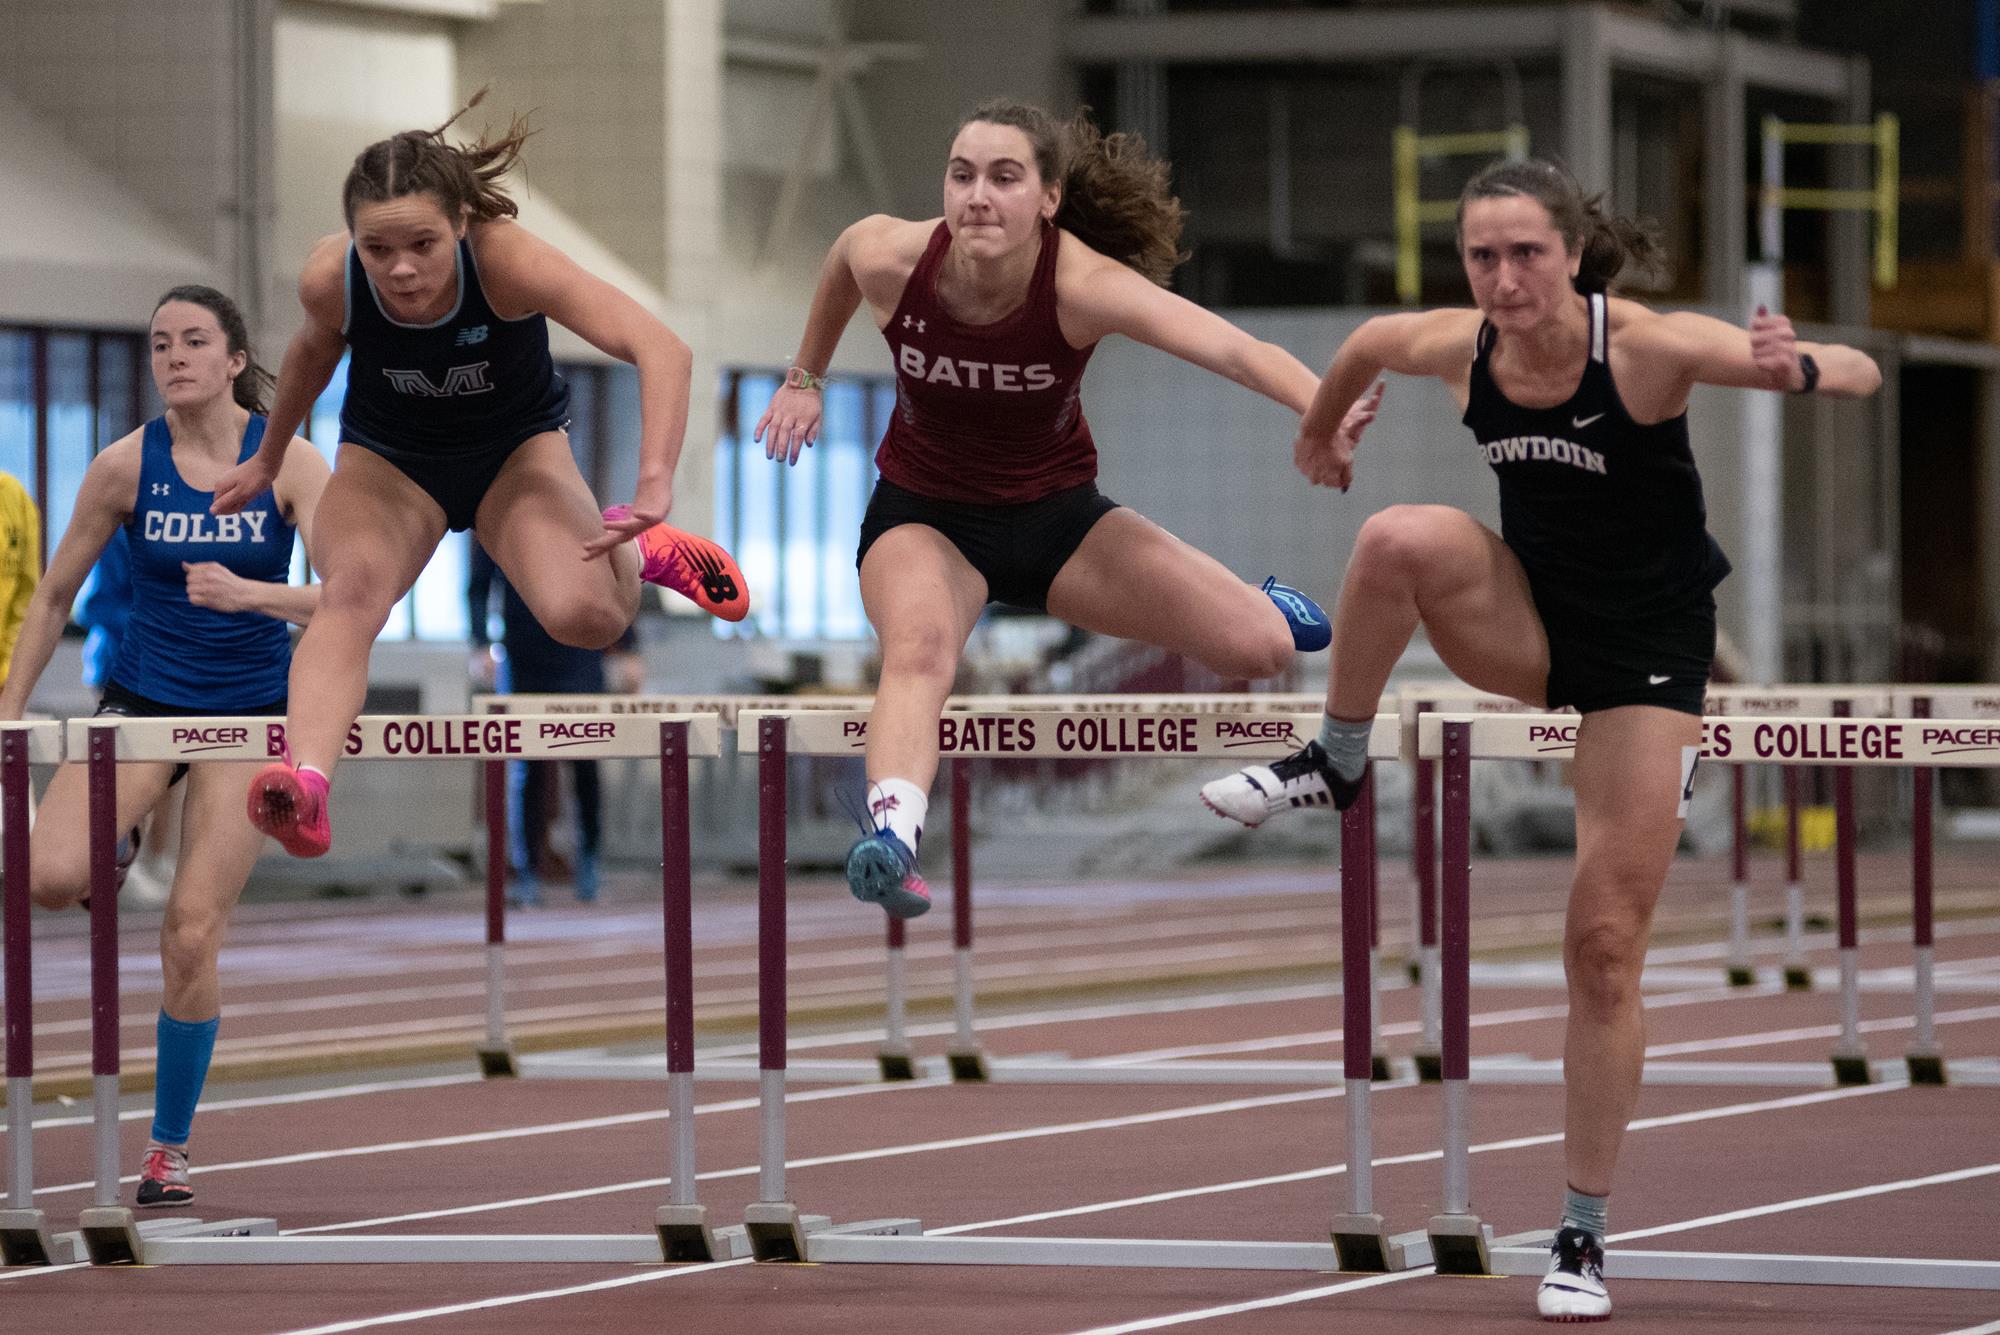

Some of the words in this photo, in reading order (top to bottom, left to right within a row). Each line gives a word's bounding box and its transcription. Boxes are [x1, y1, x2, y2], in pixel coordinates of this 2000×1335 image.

[900, 343, 1056, 392] BATES
[144, 510, 267, 543] COLBY
[173, 728, 248, 743] PACER
[383, 720, 522, 755] COLLEGE
[539, 722, 616, 739] PACER
[939, 717, 1036, 751] BATES
[1056, 718, 1198, 752] COLLEGE
[1216, 722, 1294, 738] PACER
[1529, 726, 1577, 742] PAC
[1754, 723, 1903, 759] COLLEGE
[1922, 728, 2000, 745] PACER
